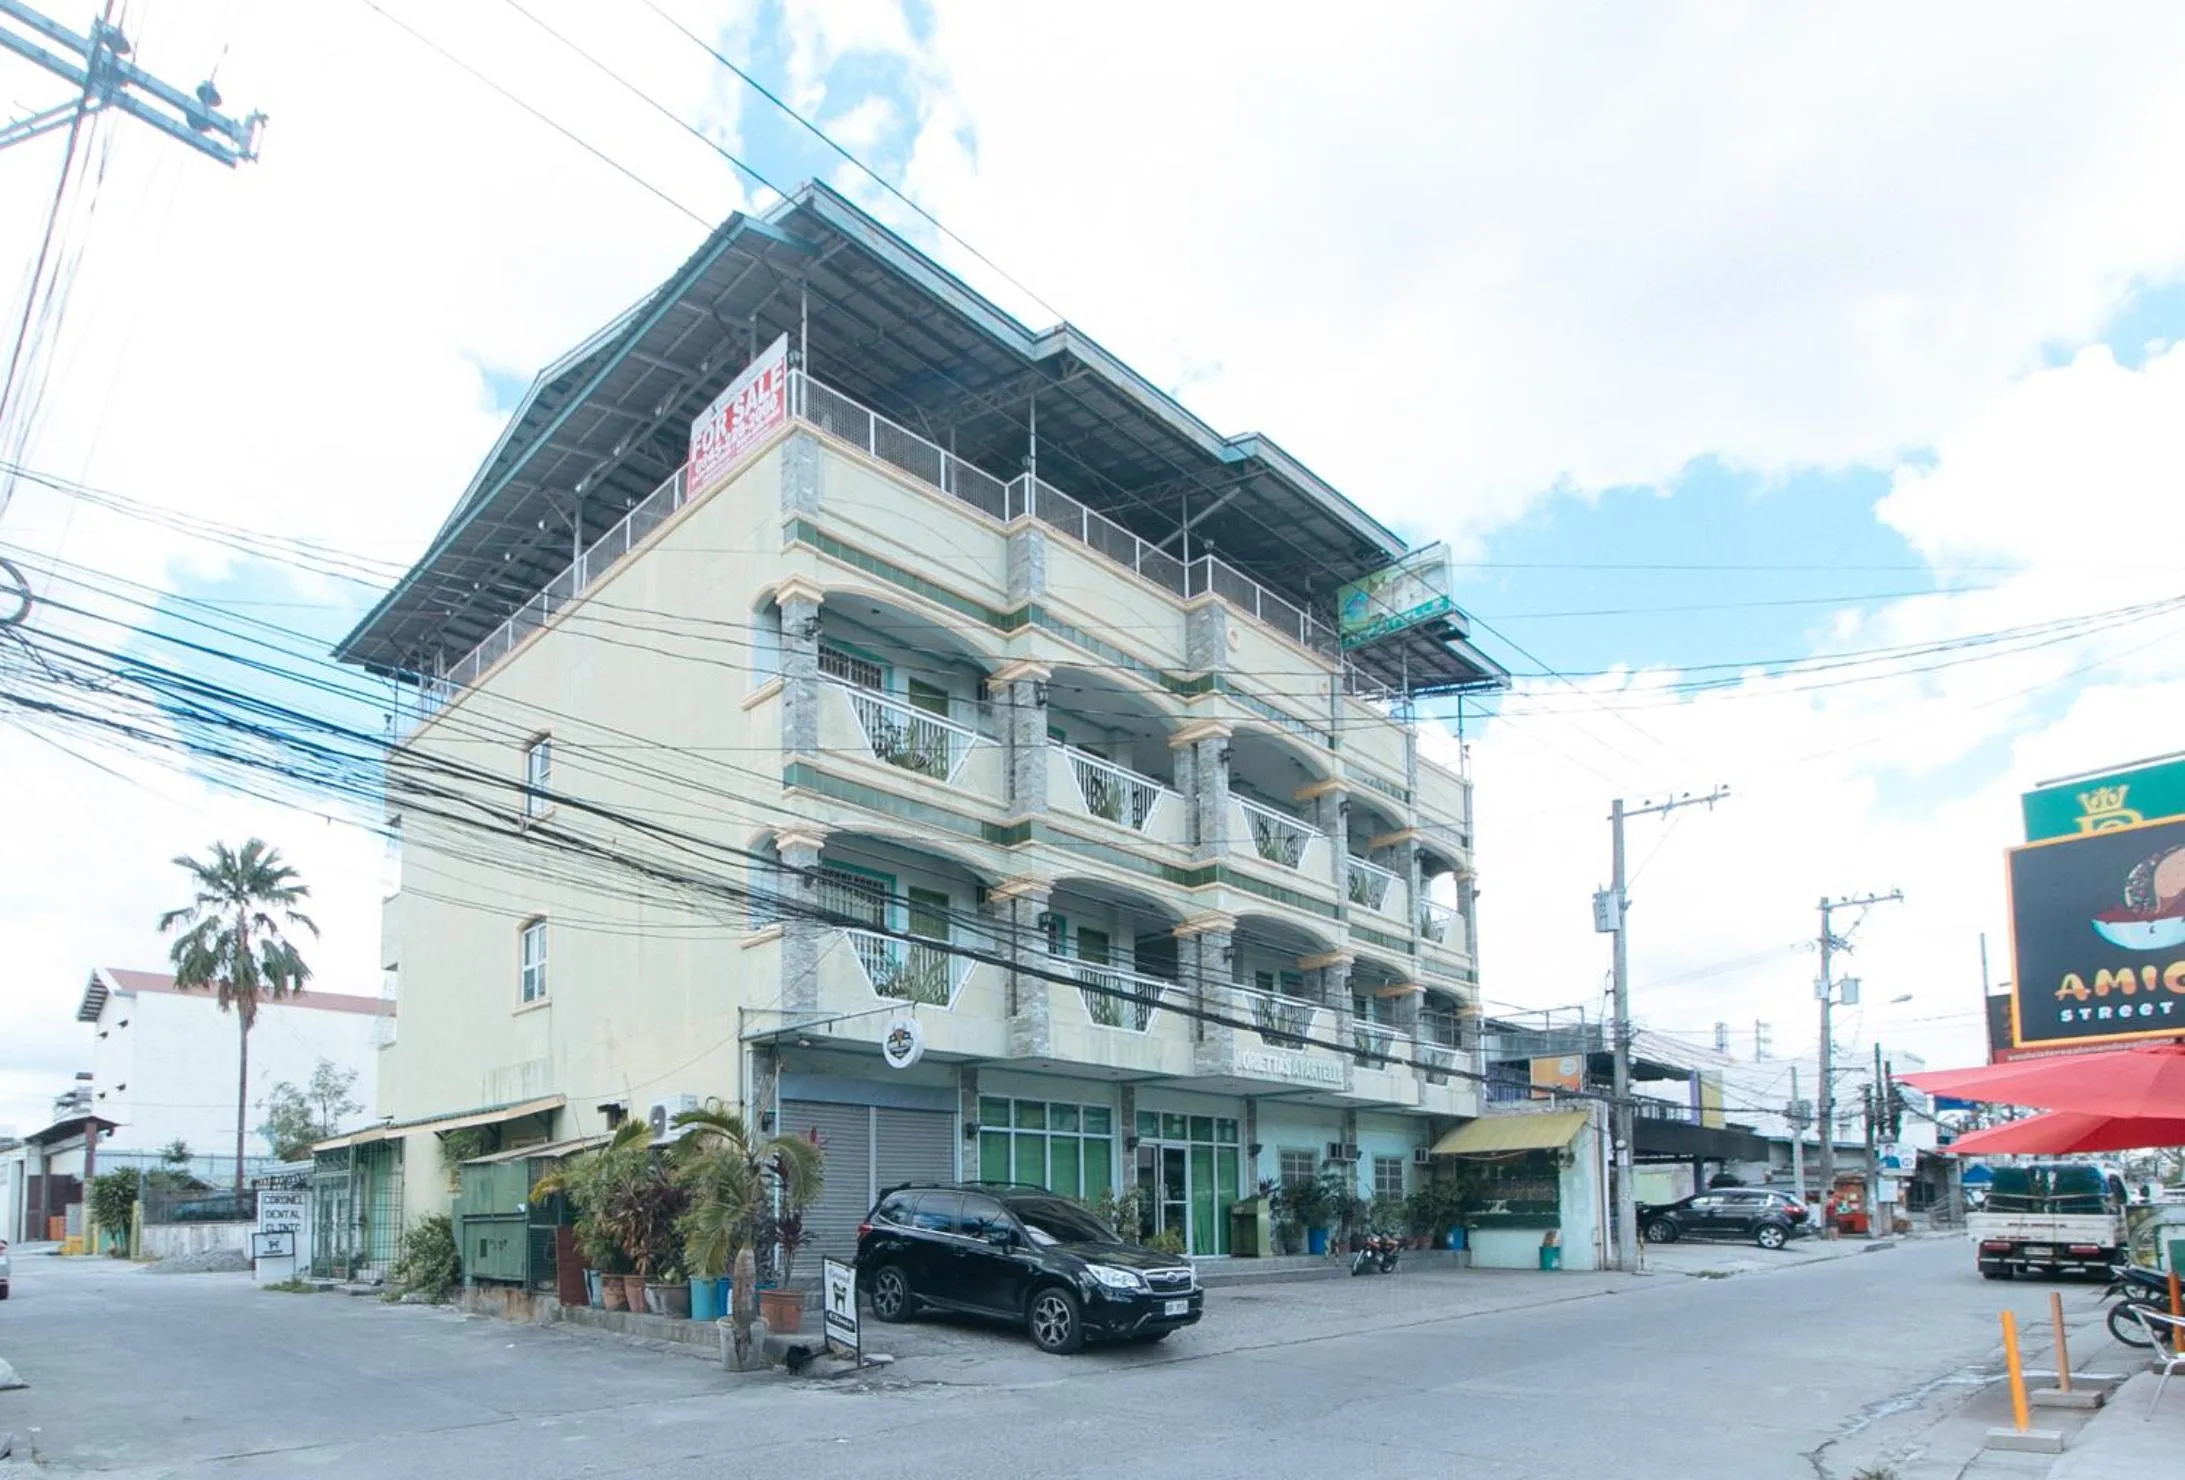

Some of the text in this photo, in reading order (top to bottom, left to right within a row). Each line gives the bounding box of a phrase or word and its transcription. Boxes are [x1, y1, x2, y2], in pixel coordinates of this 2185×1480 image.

[691, 410, 728, 464] FOR
[732, 356, 785, 437] SALE
[265, 1210, 301, 1219] DENTAL
[265, 1223, 301, 1232] CLINIC
